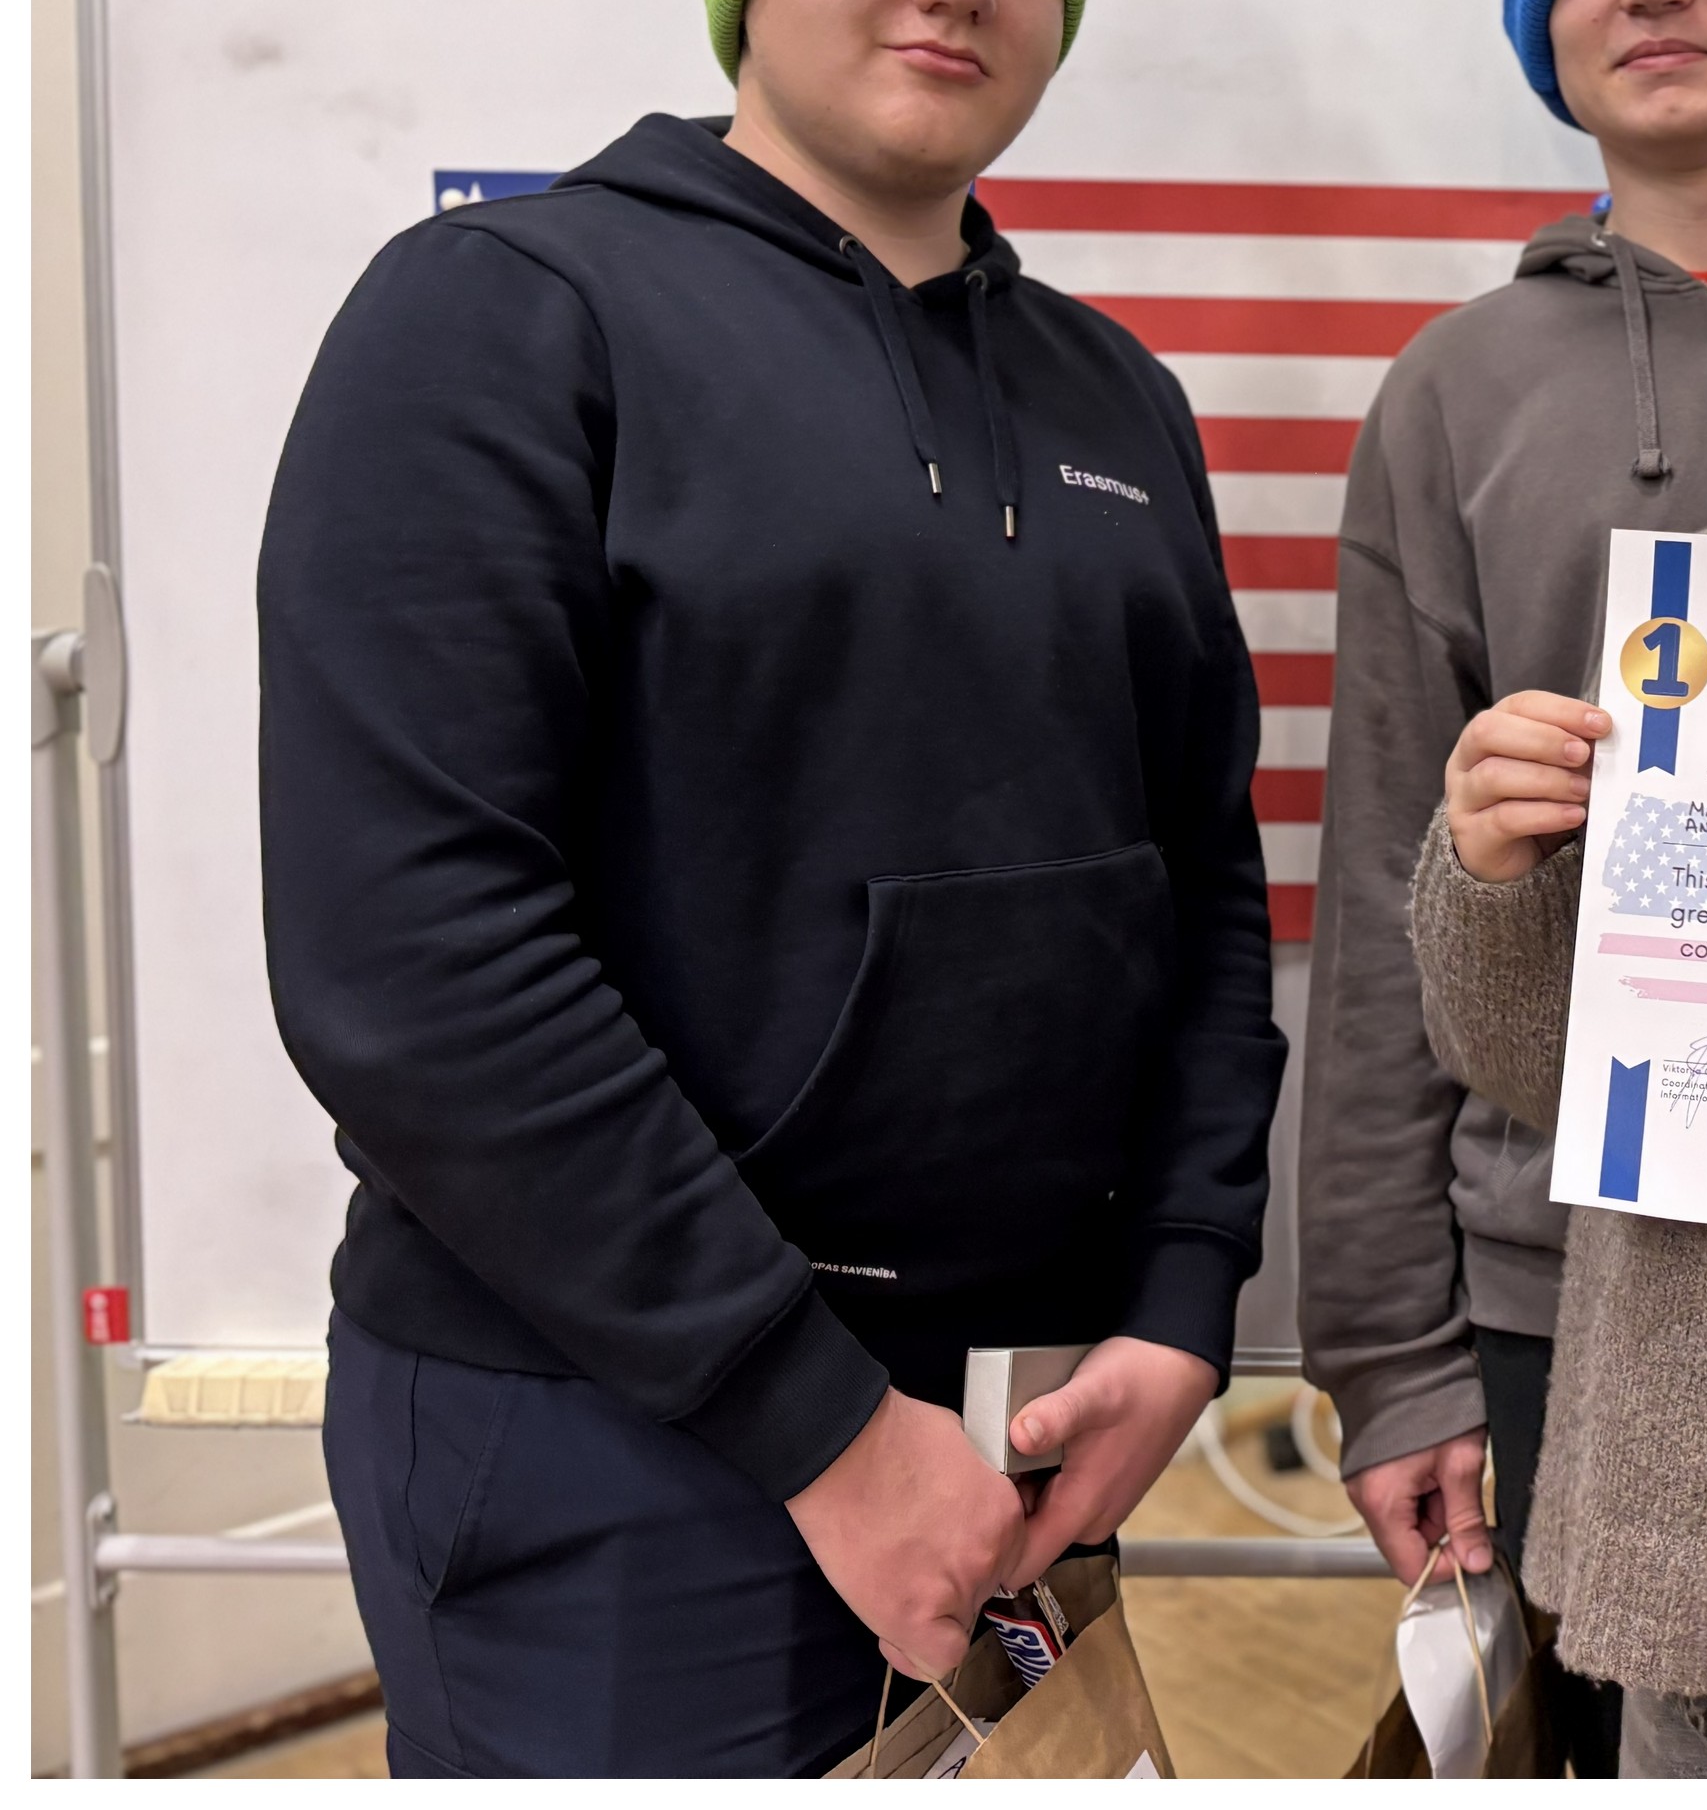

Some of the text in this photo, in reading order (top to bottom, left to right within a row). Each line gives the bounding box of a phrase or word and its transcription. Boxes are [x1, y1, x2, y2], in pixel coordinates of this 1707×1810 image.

[1058, 462, 1151, 506] Erasmus+
[1641, 622, 1690, 697] 1
[809, 1262, 897, 1279] OPAS SAVIENĪBA
